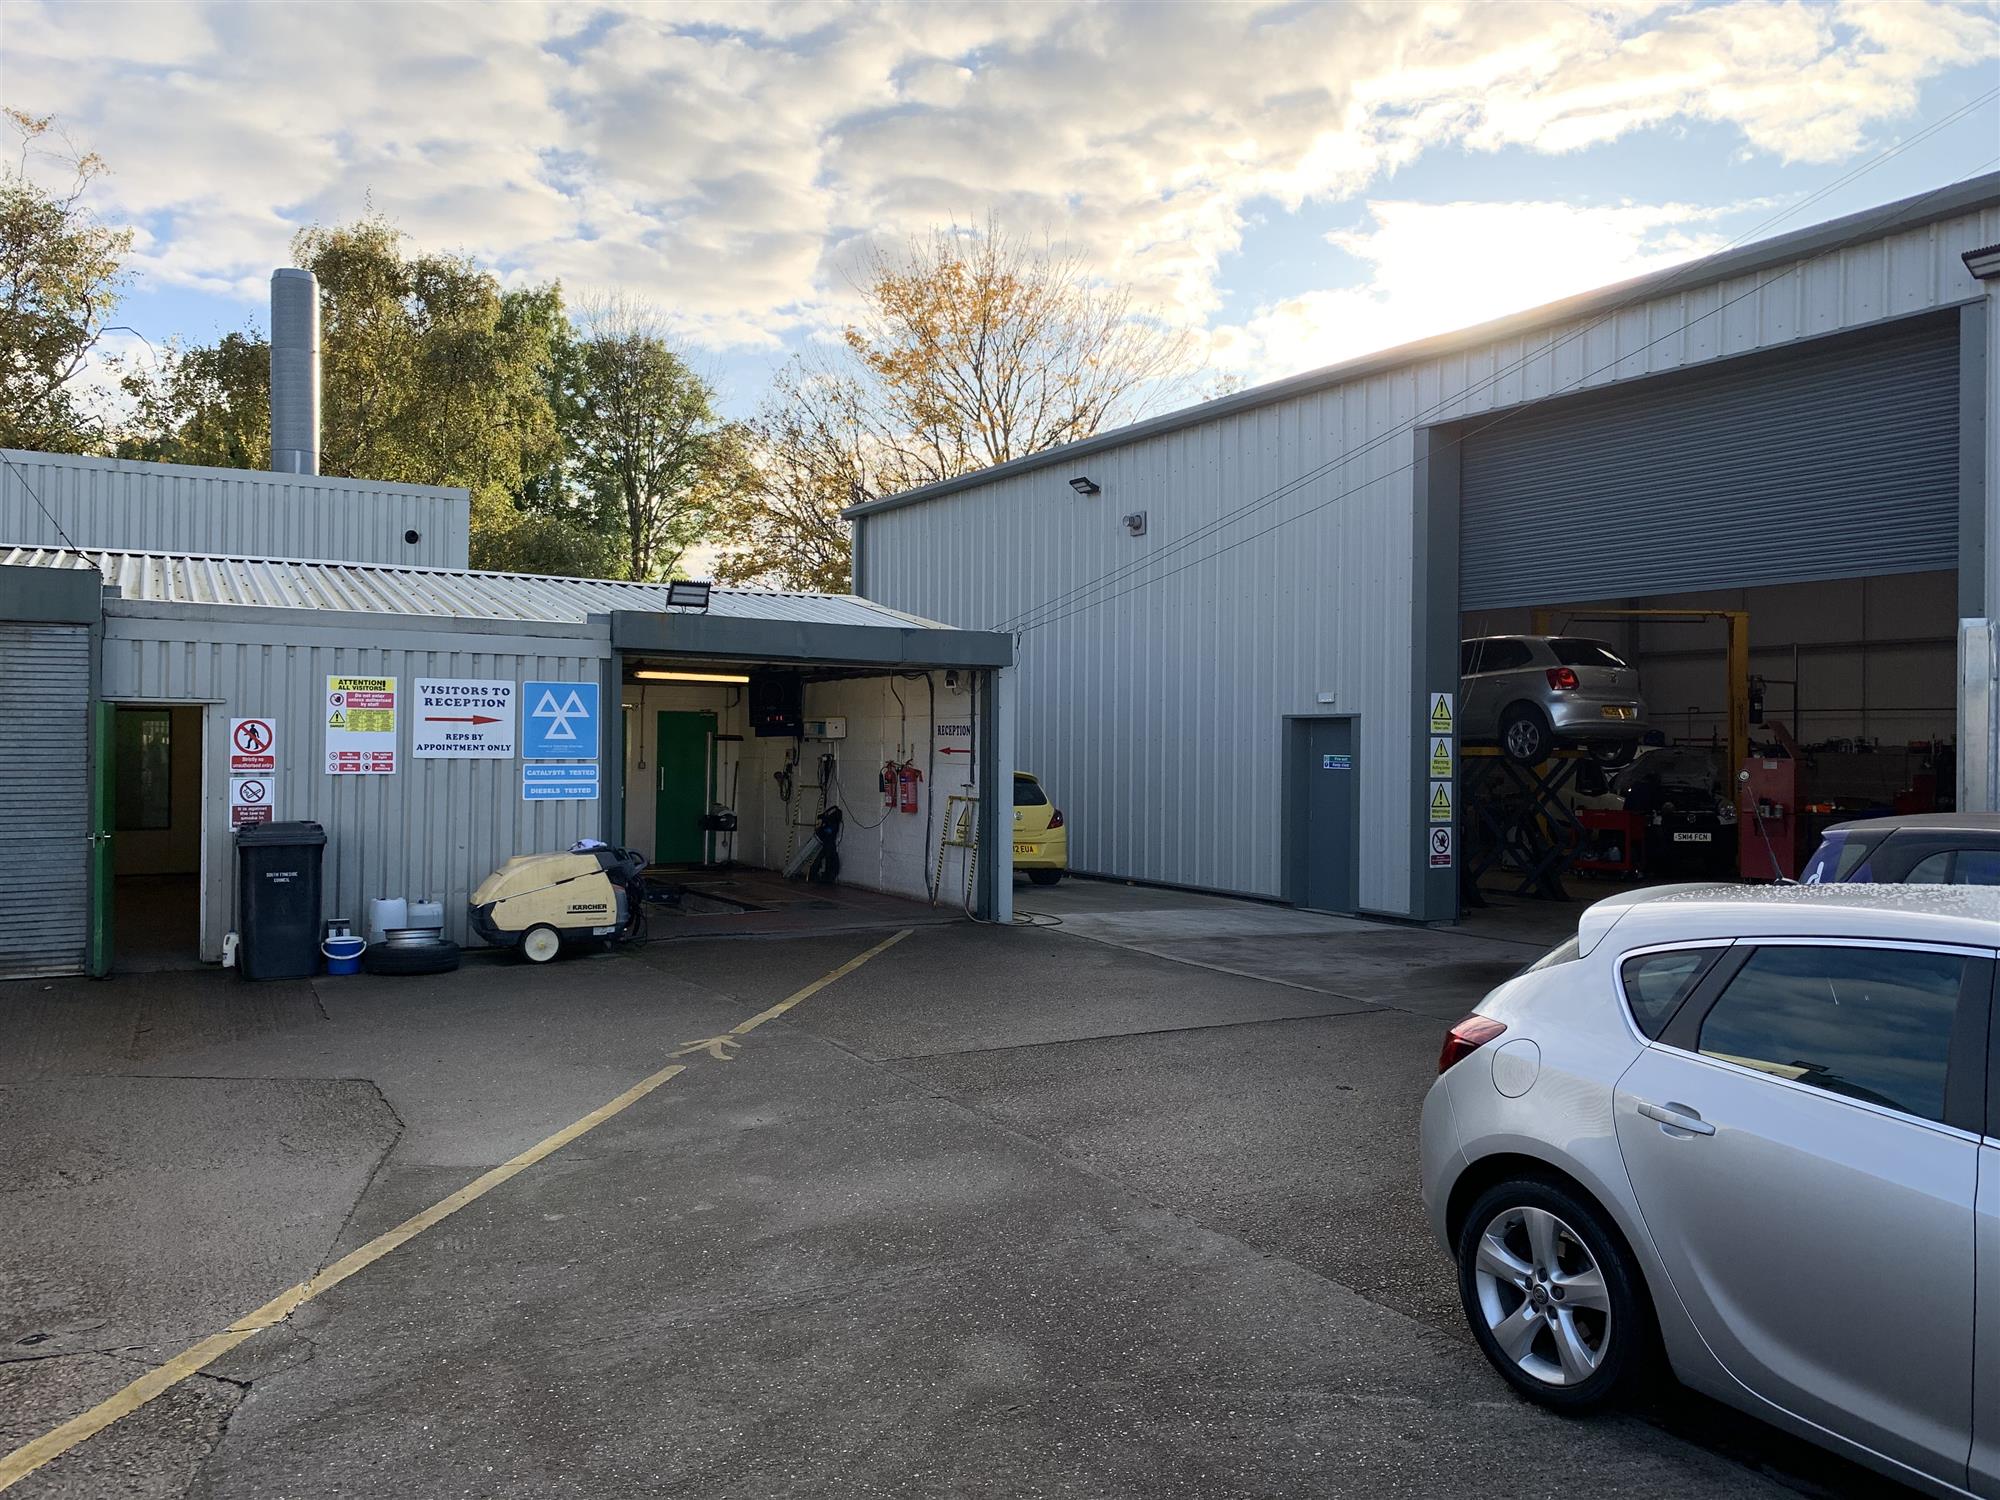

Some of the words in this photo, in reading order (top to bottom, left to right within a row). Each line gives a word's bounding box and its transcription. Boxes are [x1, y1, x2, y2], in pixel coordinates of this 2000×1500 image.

[420, 685, 488, 696] VISITORS
[492, 687, 511, 696] TO
[424, 697, 506, 708] RECEPTION
[937, 724, 971, 736] RECEPTION
[445, 733, 470, 741] REPS
[471, 733, 484, 741] BY
[416, 743, 486, 752] APPOINTMENT
[487, 744, 512, 752] ONLY
[1020, 845, 1034, 853] EUA
